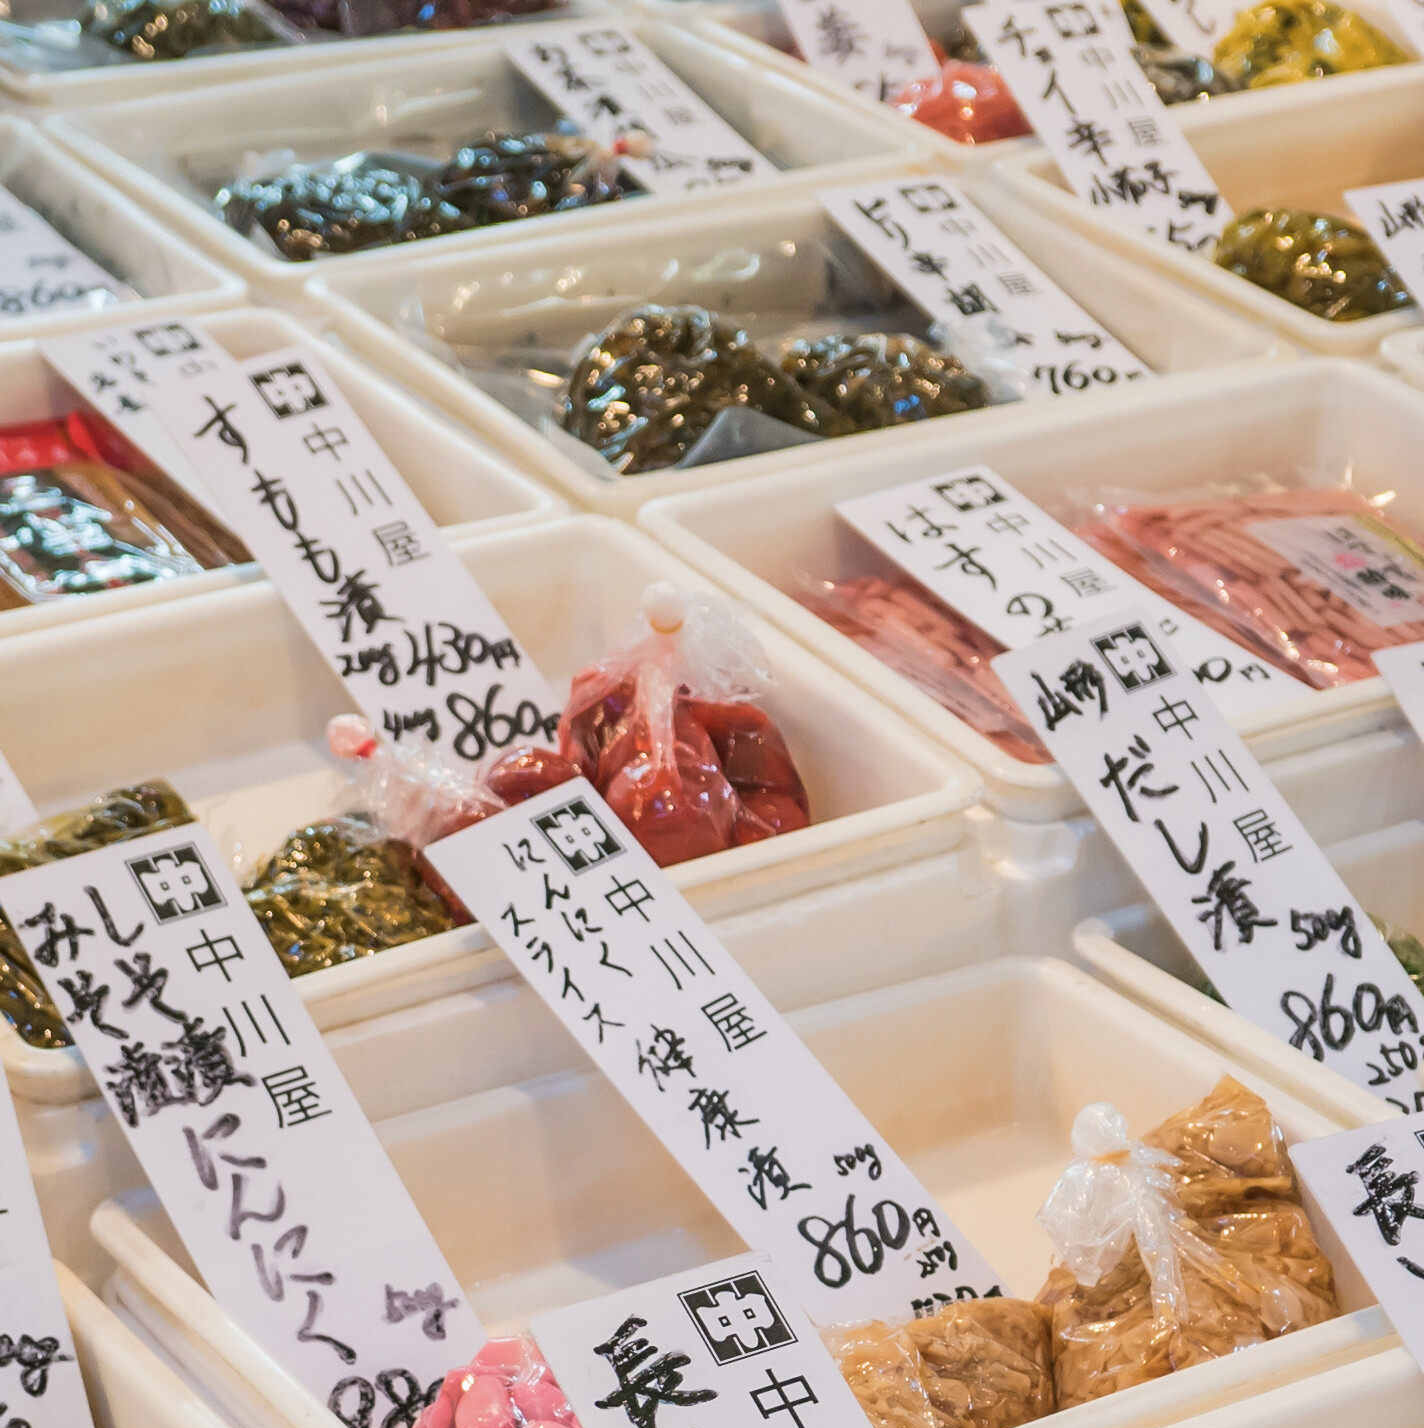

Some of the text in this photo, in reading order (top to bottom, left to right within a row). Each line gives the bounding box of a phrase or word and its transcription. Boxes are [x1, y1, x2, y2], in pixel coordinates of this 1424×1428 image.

[1080, 45, 1169, 147] 中川屋
[193, 396, 405, 643] すもも漬
[302, 422, 433, 567] 中川屋
[985, 510, 1118, 598] 中川屋
[404, 621, 520, 686] 430円
[1030, 659, 1108, 731] 山形
[1100, 734, 1278, 951] だし漬
[1153, 695, 1293, 863] 中川屋
[501, 902, 625, 1043] スライス
[502, 838, 632, 977] にんにく
[604, 875, 767, 1053] 中川屋
[186, 929, 333, 1128] 中川屋
[1281, 973, 1419, 1062] 860円
[182, 1112, 357, 1365] にんにく
[797, 1194, 940, 1289] 860円
